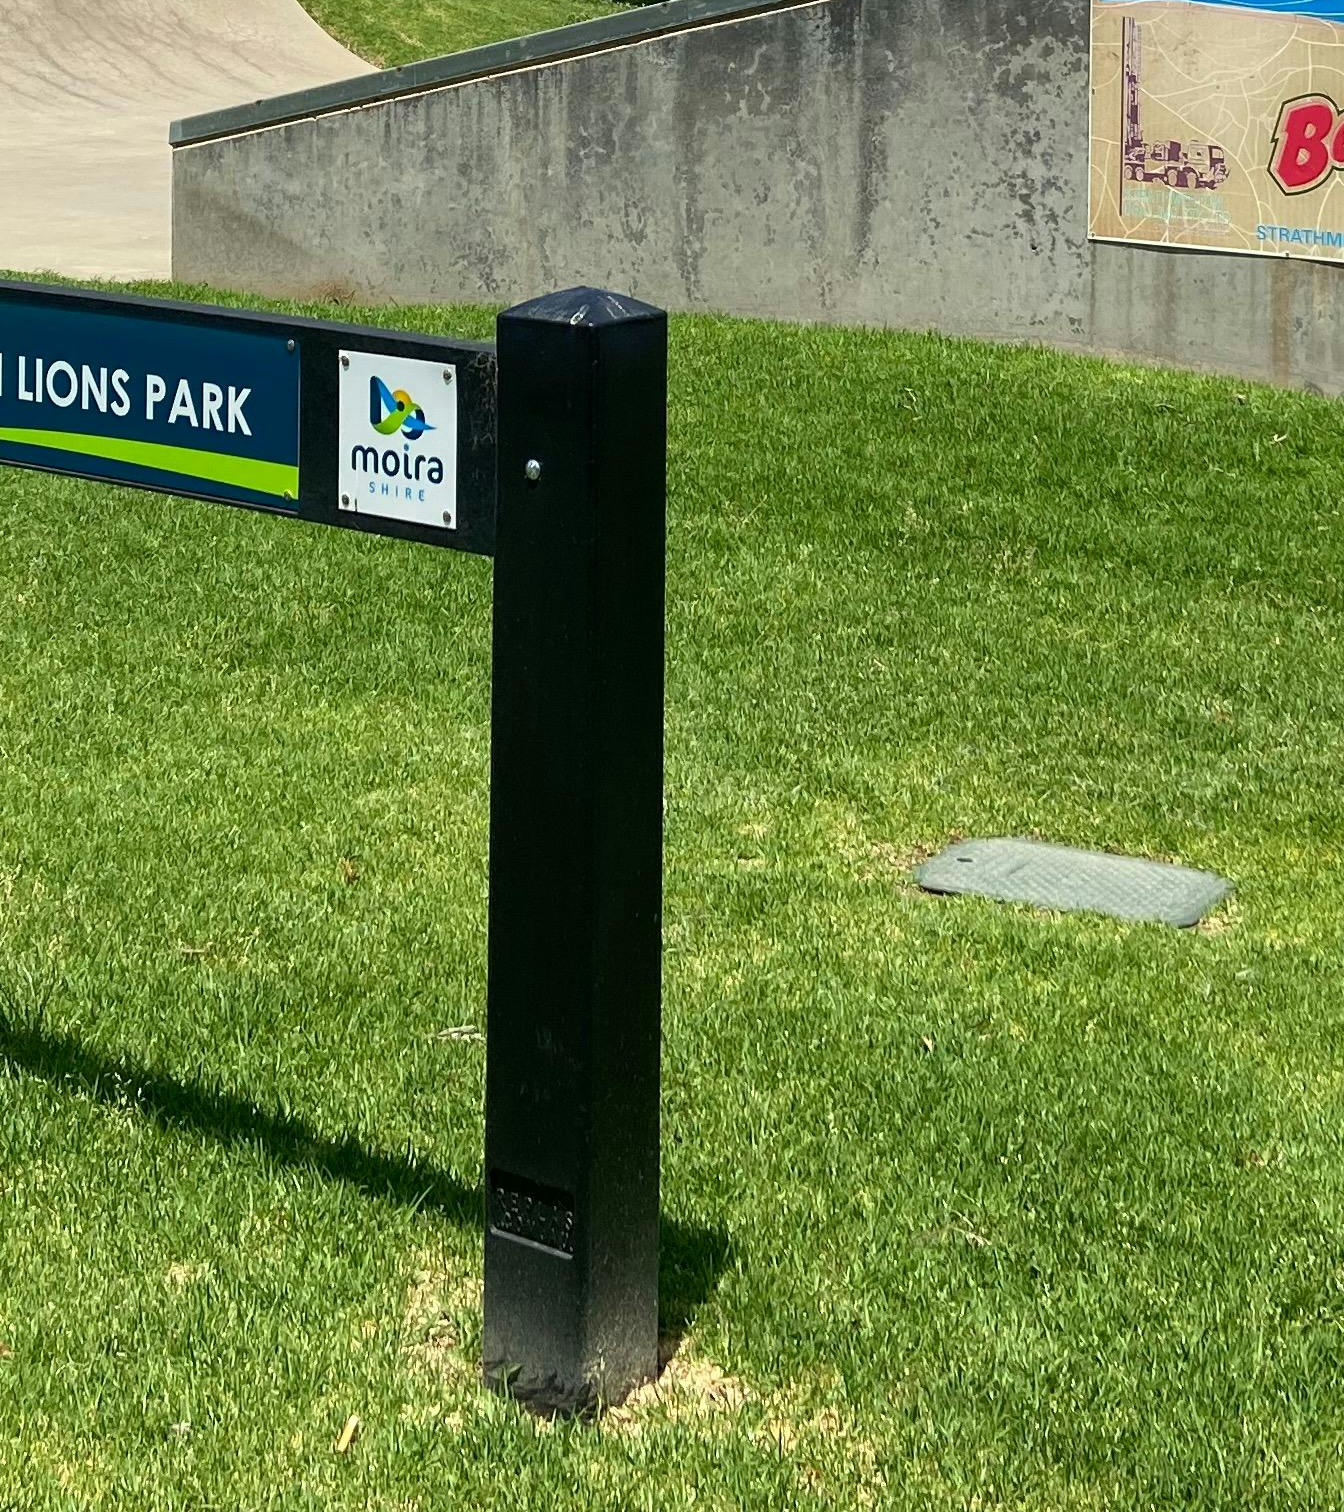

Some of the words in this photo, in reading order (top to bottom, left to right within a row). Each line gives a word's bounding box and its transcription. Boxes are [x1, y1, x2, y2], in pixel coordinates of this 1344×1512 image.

[18, 355, 130, 417] LIONS
[145, 374, 253, 437] PARK
[351, 443, 444, 485] moira
[368, 480, 426, 502] SHIRE
